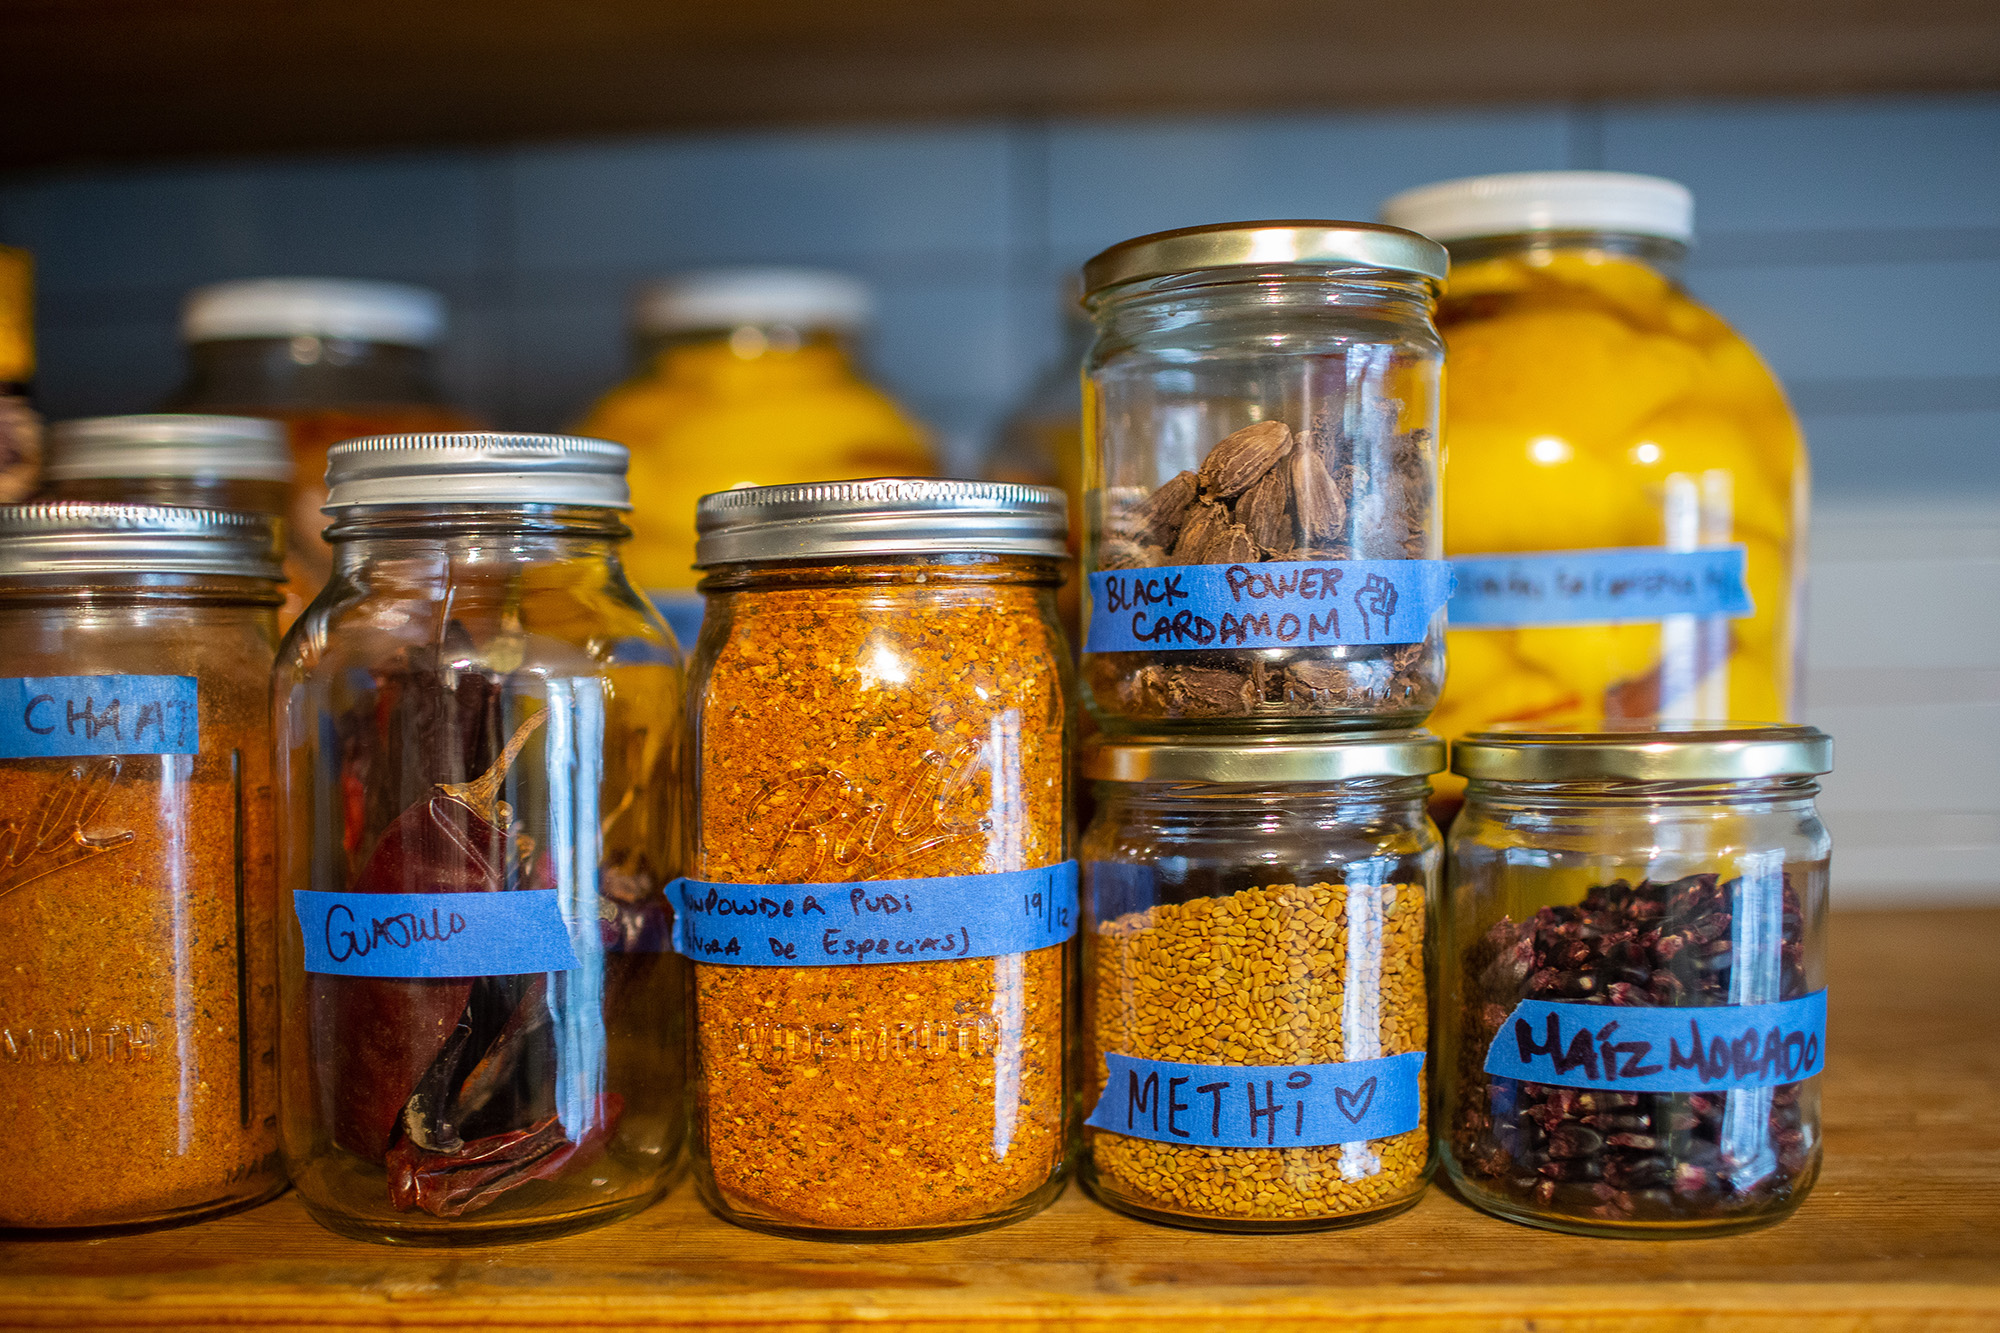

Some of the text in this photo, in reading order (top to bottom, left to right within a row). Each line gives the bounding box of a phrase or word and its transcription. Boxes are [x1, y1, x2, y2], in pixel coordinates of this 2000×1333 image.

[1105, 565, 1344, 613] BLACK POWER
[1131, 608, 1341, 646] CARDAMOM
[1669, 1018, 1818, 1084] MORADO
